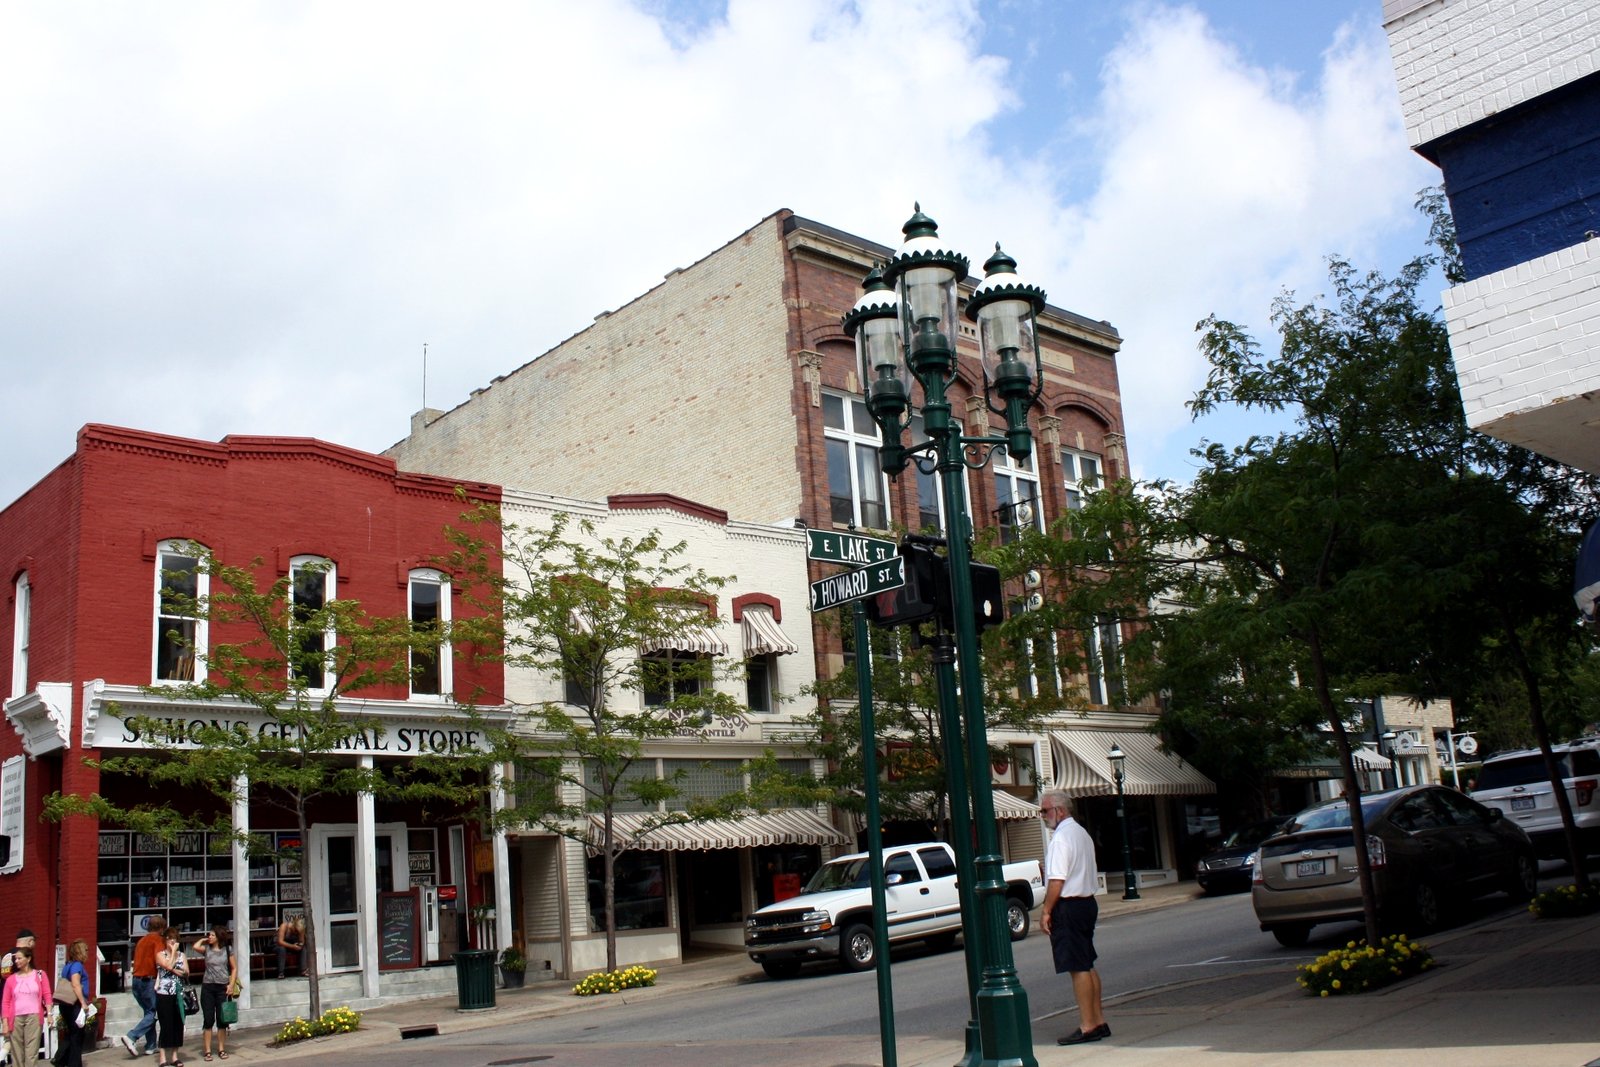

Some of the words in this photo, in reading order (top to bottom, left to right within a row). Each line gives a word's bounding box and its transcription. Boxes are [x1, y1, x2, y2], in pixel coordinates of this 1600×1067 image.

[823, 540, 833, 552] E.
[839, 536, 871, 563] LAKE
[821, 570, 868, 606] HOWARD
[878, 568, 893, 583] ST.
[258, 721, 389, 751] GERAL
[397, 728, 480, 754] STORE
[676, 728, 736, 738] MERCANTILE
[175, 834, 200, 852] JAM
